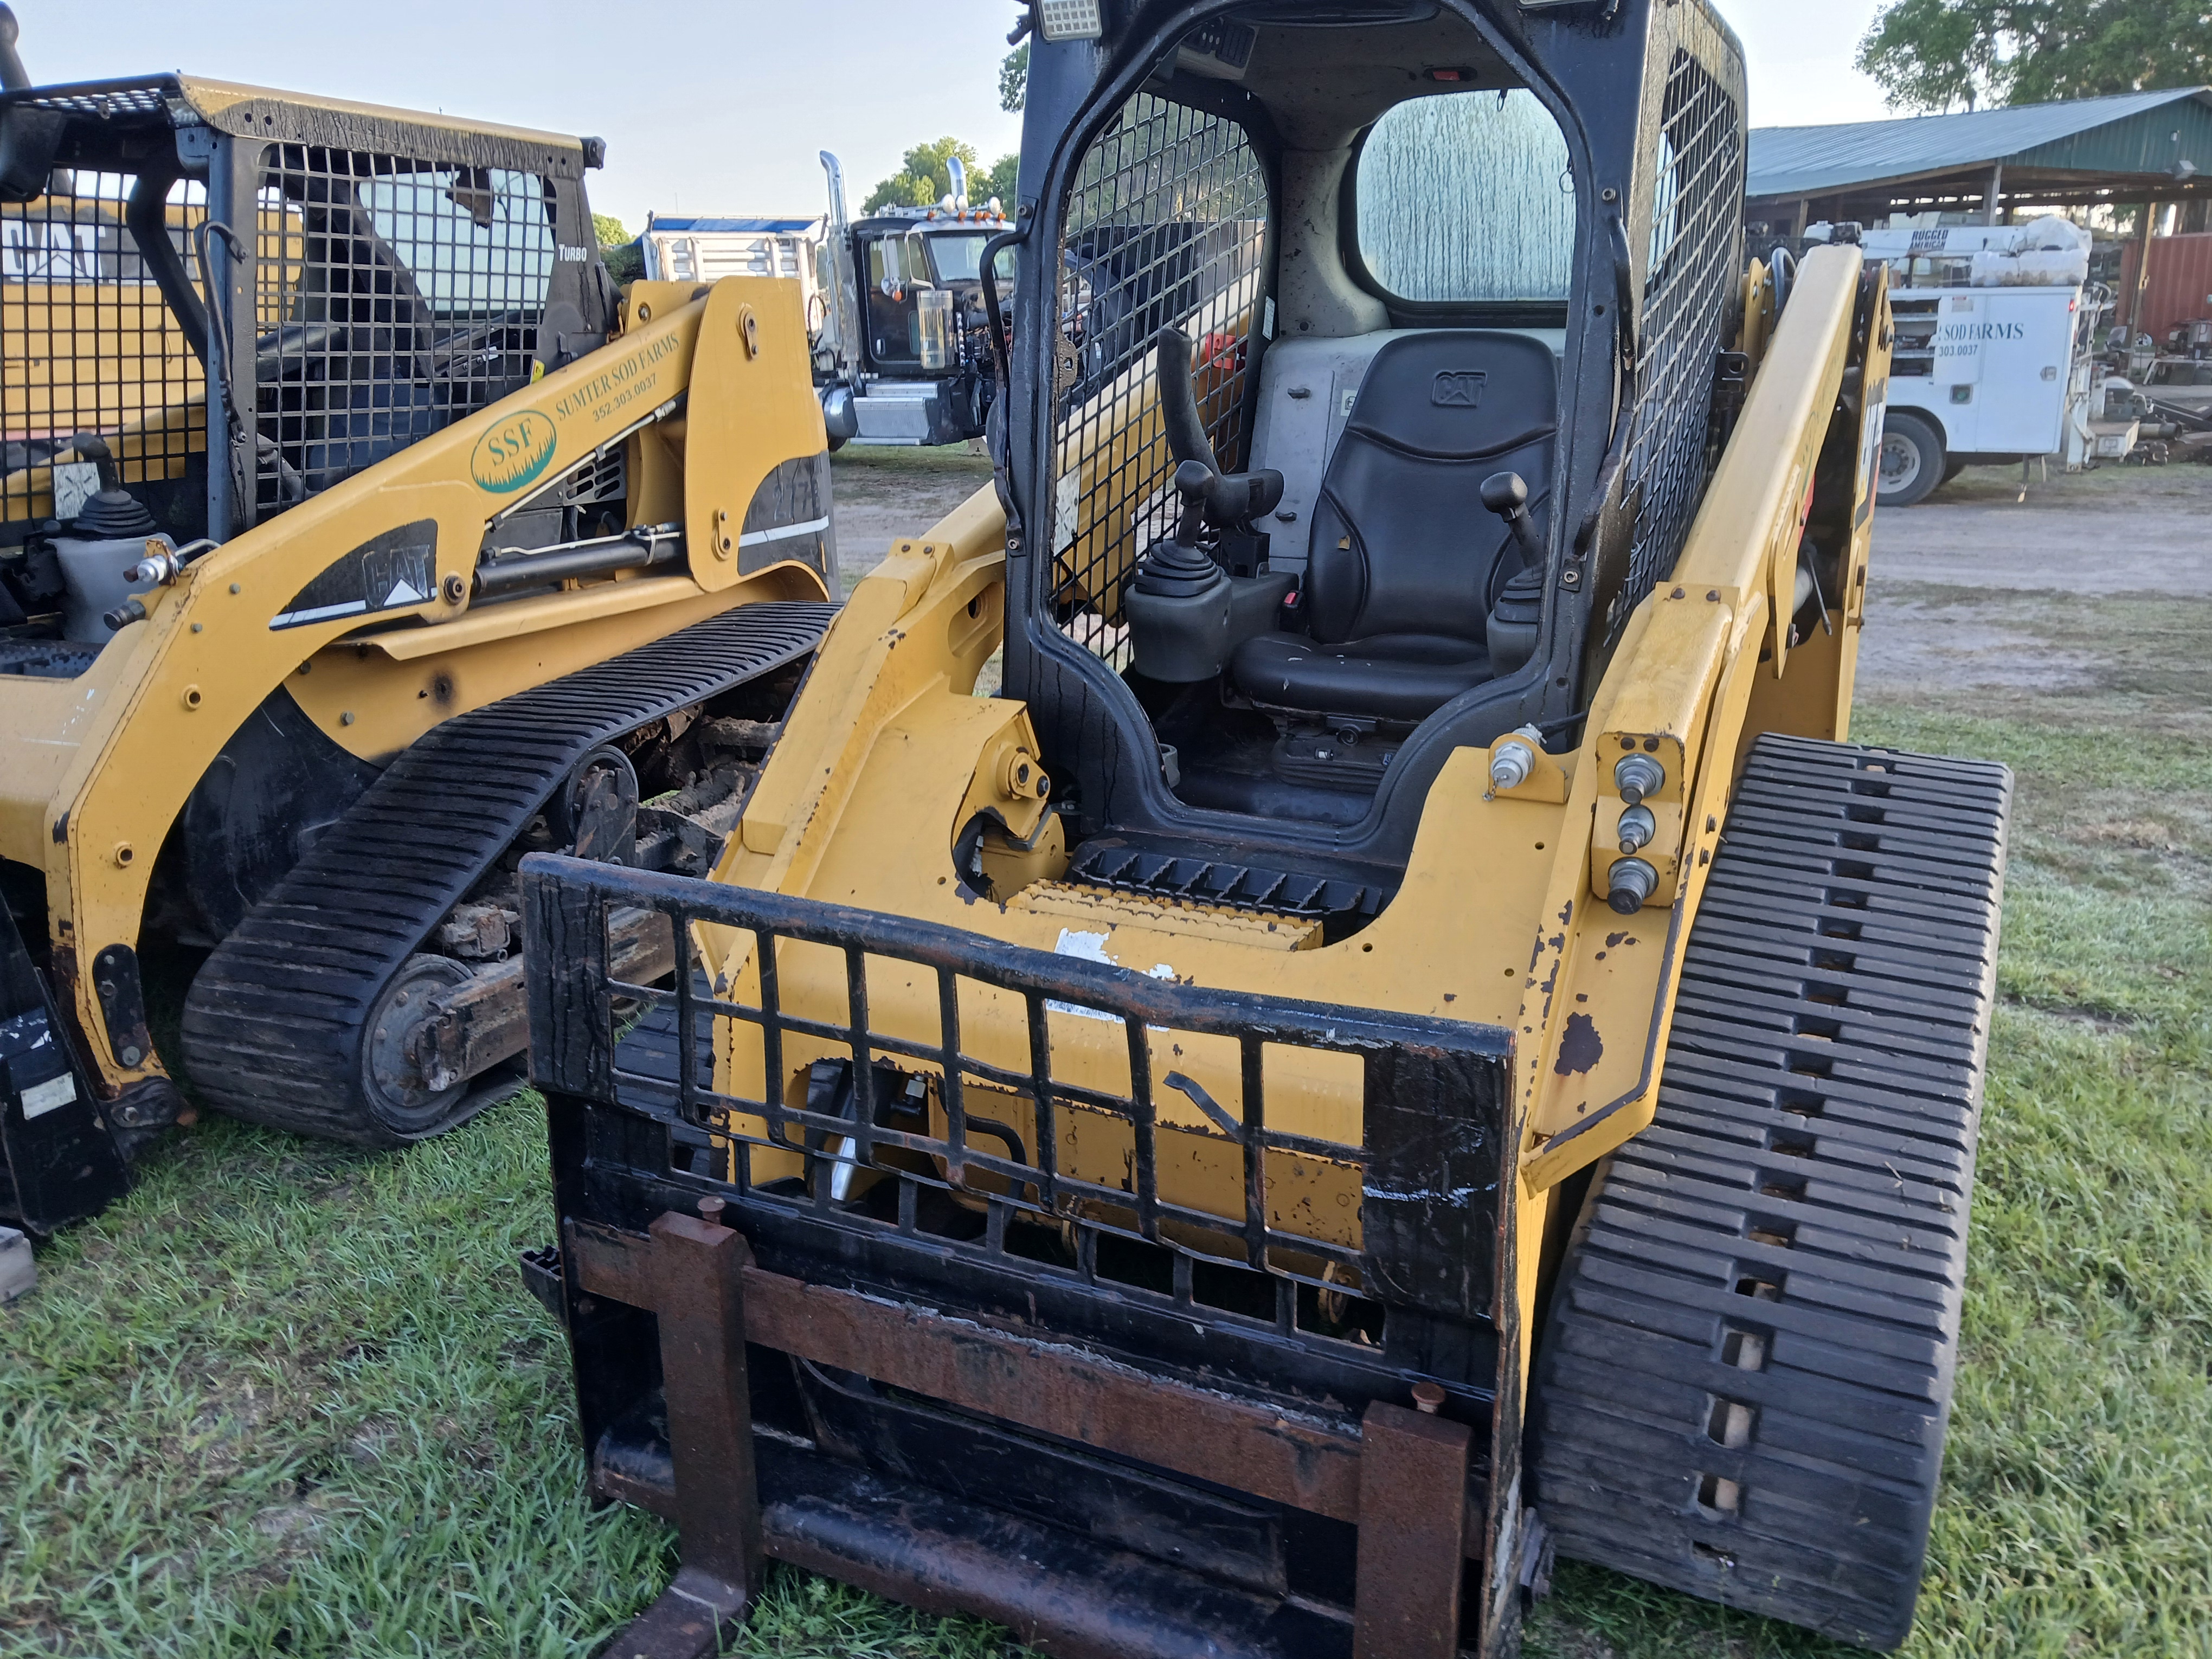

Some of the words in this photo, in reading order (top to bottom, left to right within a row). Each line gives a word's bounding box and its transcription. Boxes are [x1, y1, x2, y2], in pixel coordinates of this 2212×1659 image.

[1, 220, 106, 283] CAT
[558, 243, 587, 262] TURBO
[1909, 240, 1946, 250] AMERICAN
[1912, 230, 1949, 240] RUGGED
[1938, 344, 1978, 357] 303.0037
[1944, 324, 1966, 341] SOD
[1969, 322, 2024, 340] FARMS
[556, 374, 612, 421] SUMTER
[612, 358, 638, 387] SOD
[639, 331, 679, 370] FARMS
[1431, 370, 1487, 408] CAT
[593, 372, 657, 422] 352.303.0037
[488, 417, 532, 467] SSF
[362, 543, 430, 608] CAT
